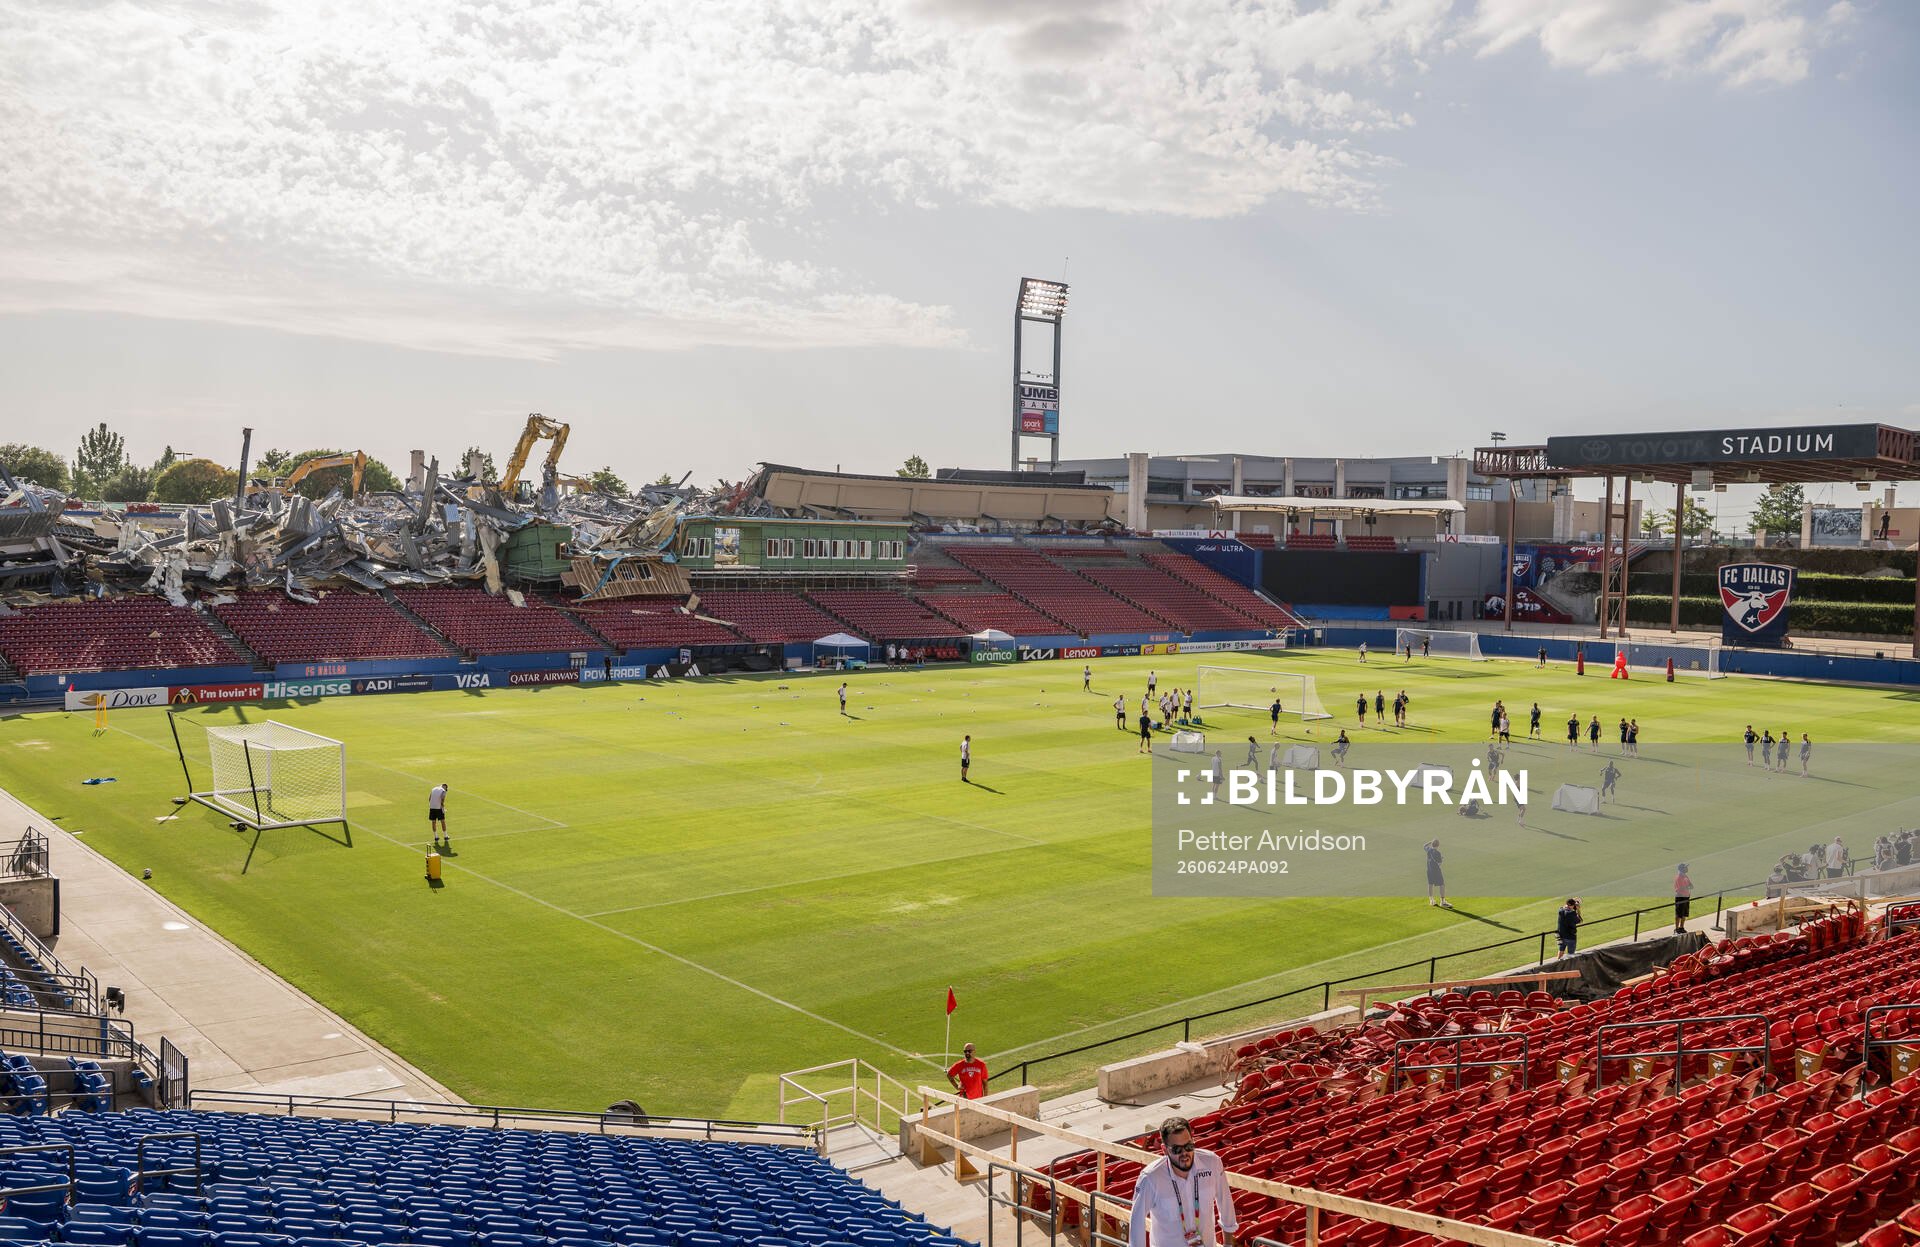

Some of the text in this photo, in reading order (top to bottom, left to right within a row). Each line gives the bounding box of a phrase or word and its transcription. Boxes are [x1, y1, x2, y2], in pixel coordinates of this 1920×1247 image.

[1021, 387, 1058, 399] UMB
[1024, 420, 1040, 429] spark
[1618, 434, 1833, 458] TOYOTA STADIUM
[1724, 567, 1785, 586] FC DALLAS
[976, 651, 1012, 661] aramco
[1023, 648, 1055, 660] KIA
[1064, 648, 1097, 658] Lenovo
[455, 673, 490, 688] VISA
[510, 671, 579, 684] QATAR AIRWAYS
[263, 682, 352, 698] Hisense
[366, 680, 392, 691] ADI
[112, 690, 157, 707] Dove
[200, 690, 217, 699] i'm
[219, 688, 248, 698] lovin'
